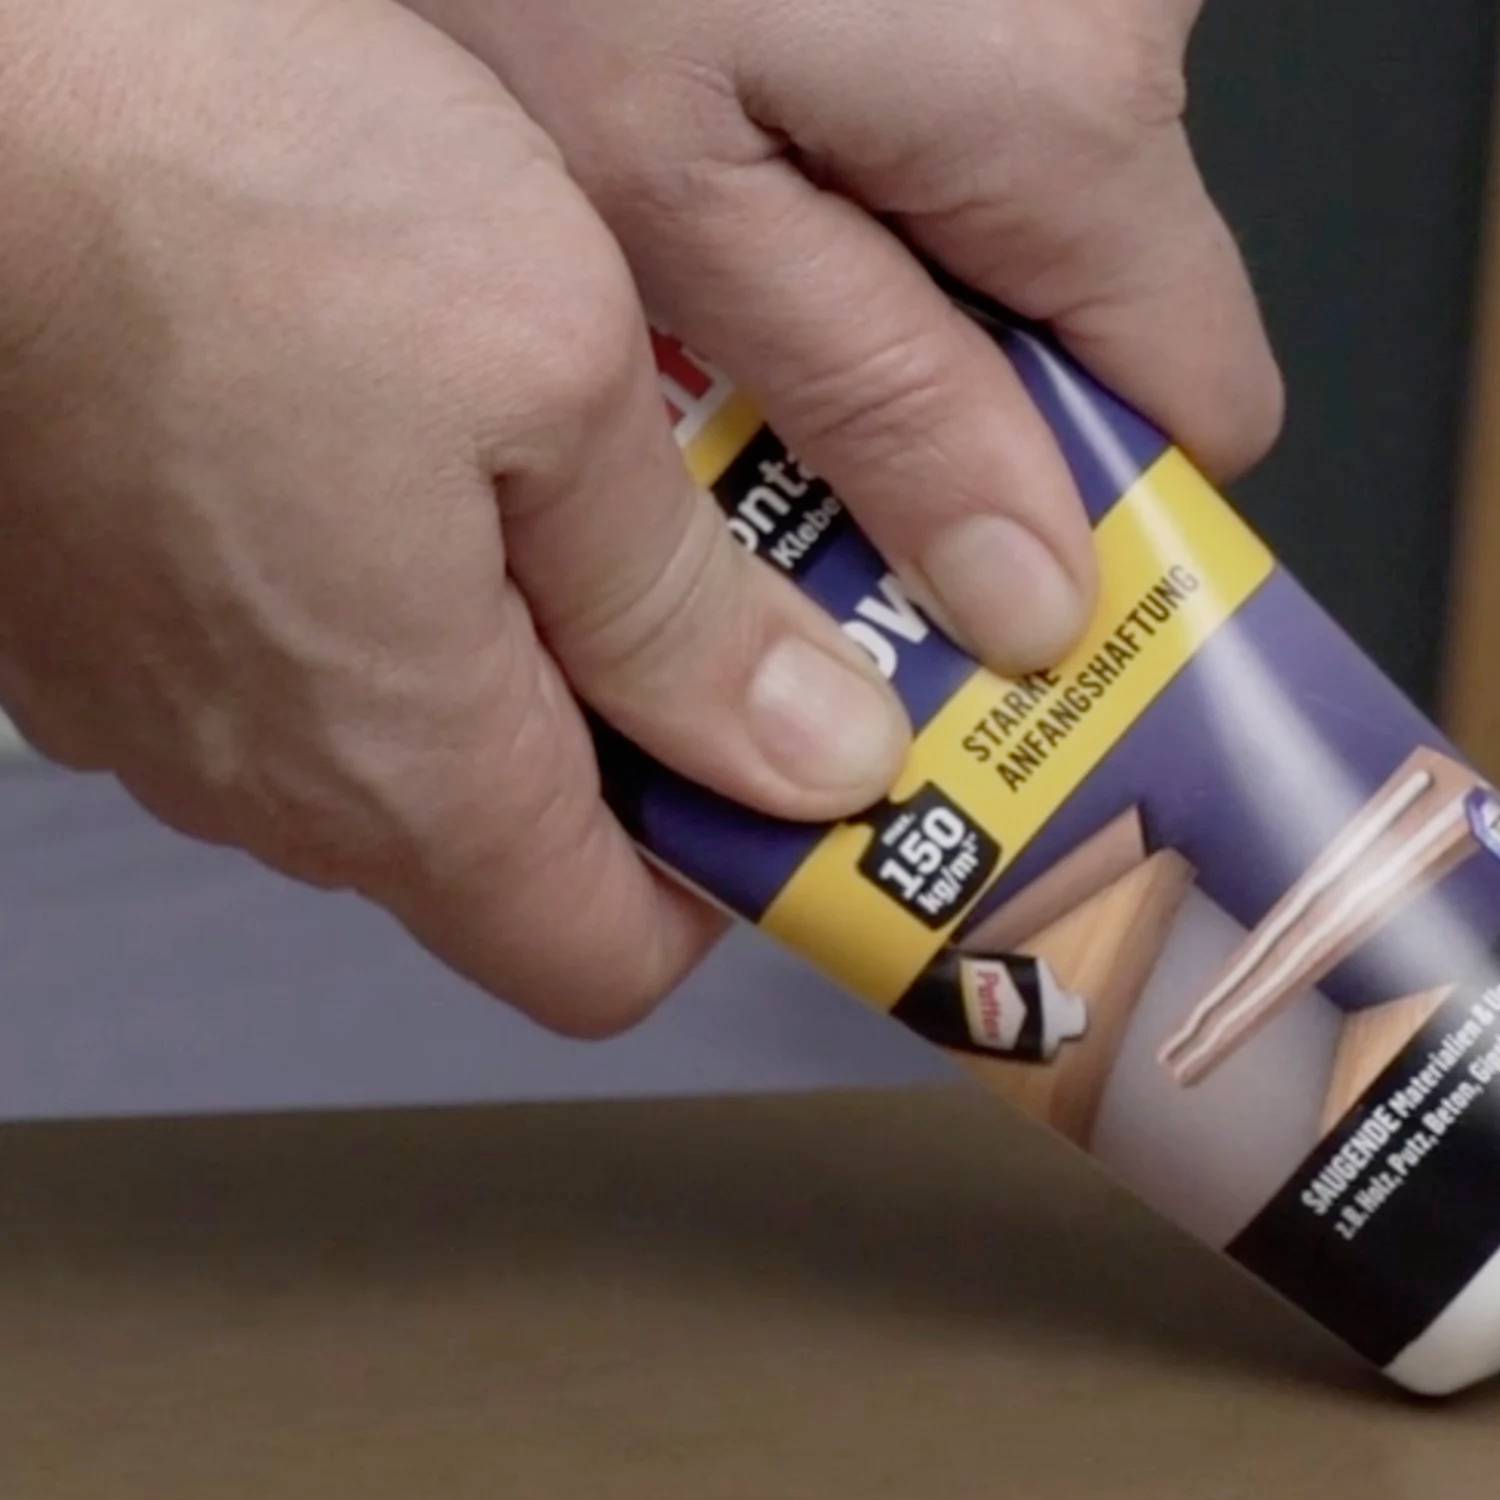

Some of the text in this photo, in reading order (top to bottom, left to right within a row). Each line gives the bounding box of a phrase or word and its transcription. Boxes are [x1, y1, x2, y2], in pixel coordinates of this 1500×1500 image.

[771, 496, 841, 569] Klebe
[993, 565, 1199, 792] ANFANGSHAFTUNG
[878, 804, 966, 900] 150
[1301, 1104, 1401, 1216] SAUGENDE
[1390, 1015, 1483, 1119] Materialien
[1470, 1001, 1496, 1027] &
